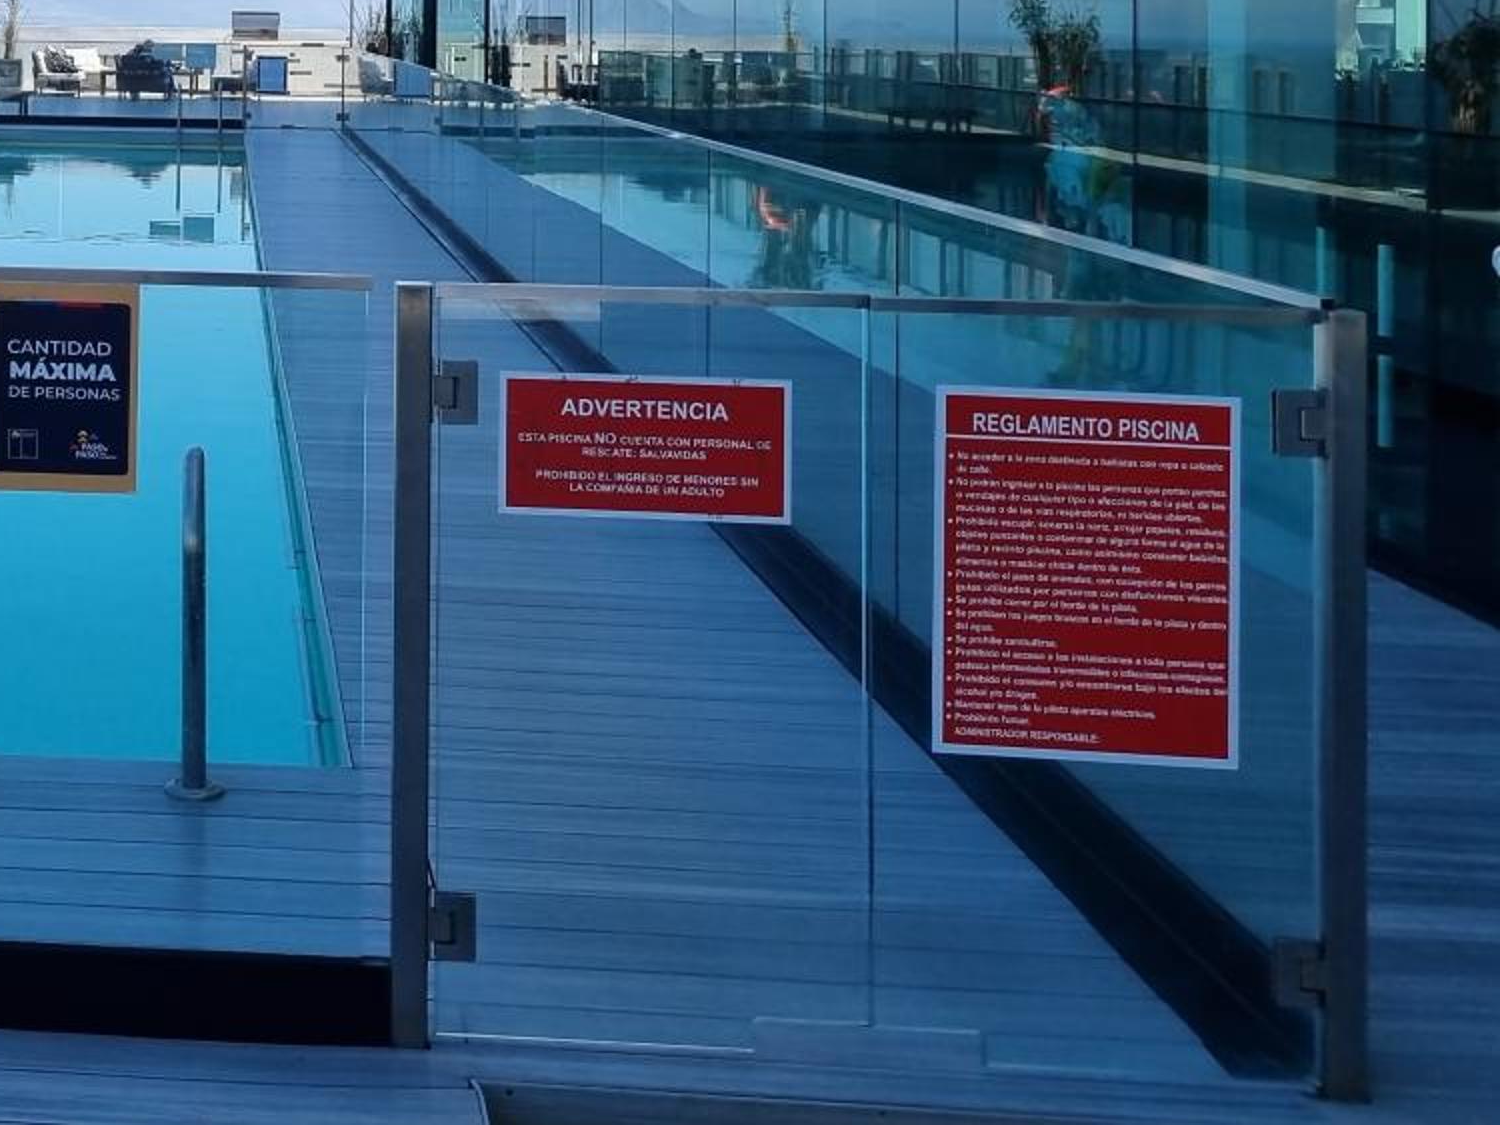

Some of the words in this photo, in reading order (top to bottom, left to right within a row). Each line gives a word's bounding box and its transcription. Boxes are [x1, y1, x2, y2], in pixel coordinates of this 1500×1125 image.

[7, 338, 112, 357] CANTIDAD
[9, 356, 117, 382] MÁXIMA
[9, 385, 30, 398] DE
[35, 386, 121, 401] PERSONAS
[561, 398, 729, 421] ADVERTENCIA
[973, 412, 1113, 437] REGLAMENTO
[1118, 418, 1200, 442] PISCINA
[518, 432, 546, 442] ESTA
[547, 433, 592, 444] PISCINA
[594, 432, 617, 444] NO
[666, 437, 691, 448] CON
[693, 438, 754, 450] PERSONAL
[569, 482, 583, 492] LA
[645, 484, 660, 495] DE
[741, 476, 759, 488] SIN
